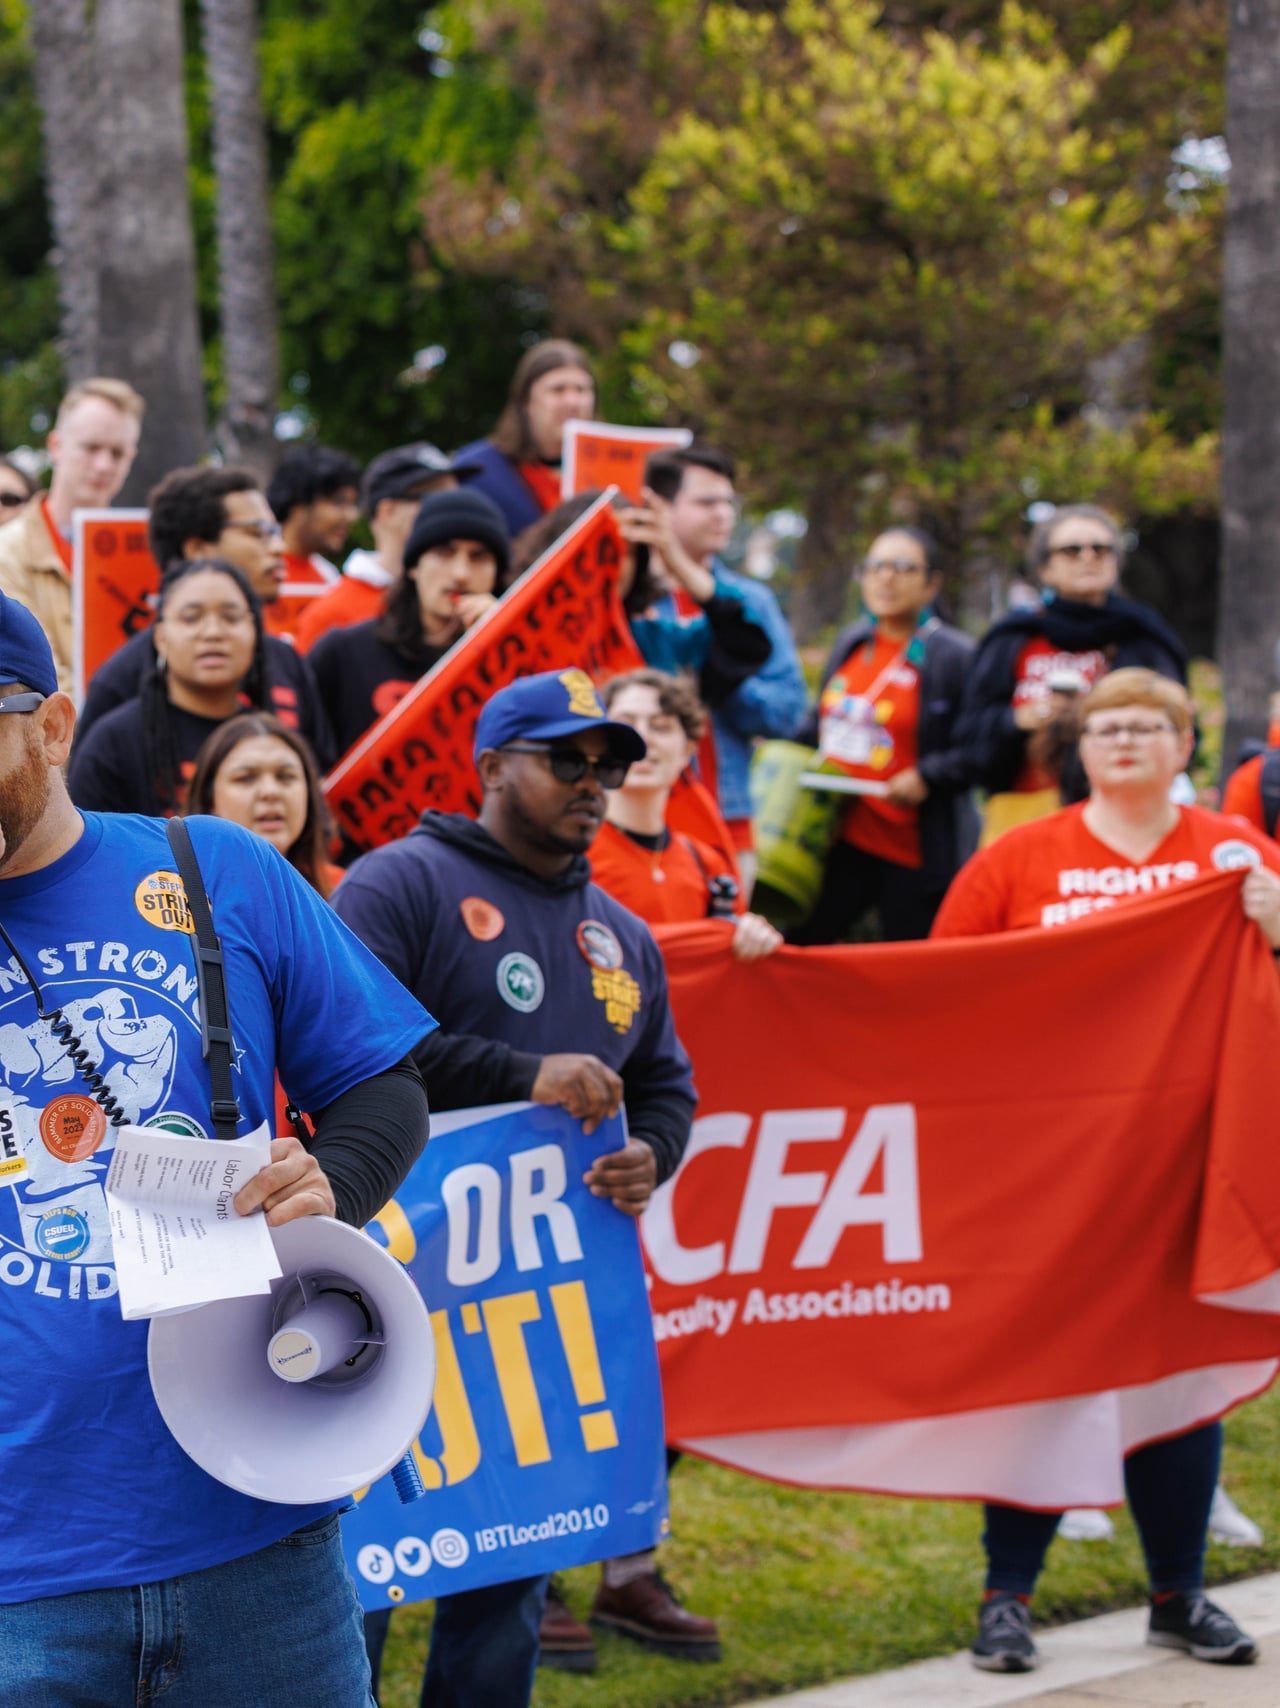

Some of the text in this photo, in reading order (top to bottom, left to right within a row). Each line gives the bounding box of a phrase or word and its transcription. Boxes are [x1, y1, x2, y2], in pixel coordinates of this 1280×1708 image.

[159, 881, 181, 891] STEP
[1058, 860, 1199, 897] RIGHTS
[143, 893, 191, 912] STRIK
[161, 908, 191, 929] OUT
[37, 941, 201, 1025] STRON
[48, 1111, 62, 1145] SUMMER
[57, 1102, 69, 1113] OF
[63, 1123, 85, 1135] 2023
[222, 1159, 241, 1189] Labor
[640, 1101, 924, 1286] CFA
[44, 1223, 74, 1237] CSUEU
[441, 1143, 584, 1288] OR
[651, 1278, 951, 1343] aculty Association
[413, 1279, 620, 1491] UT!
[475, 1504, 610, 1554] IBTLocal2010
